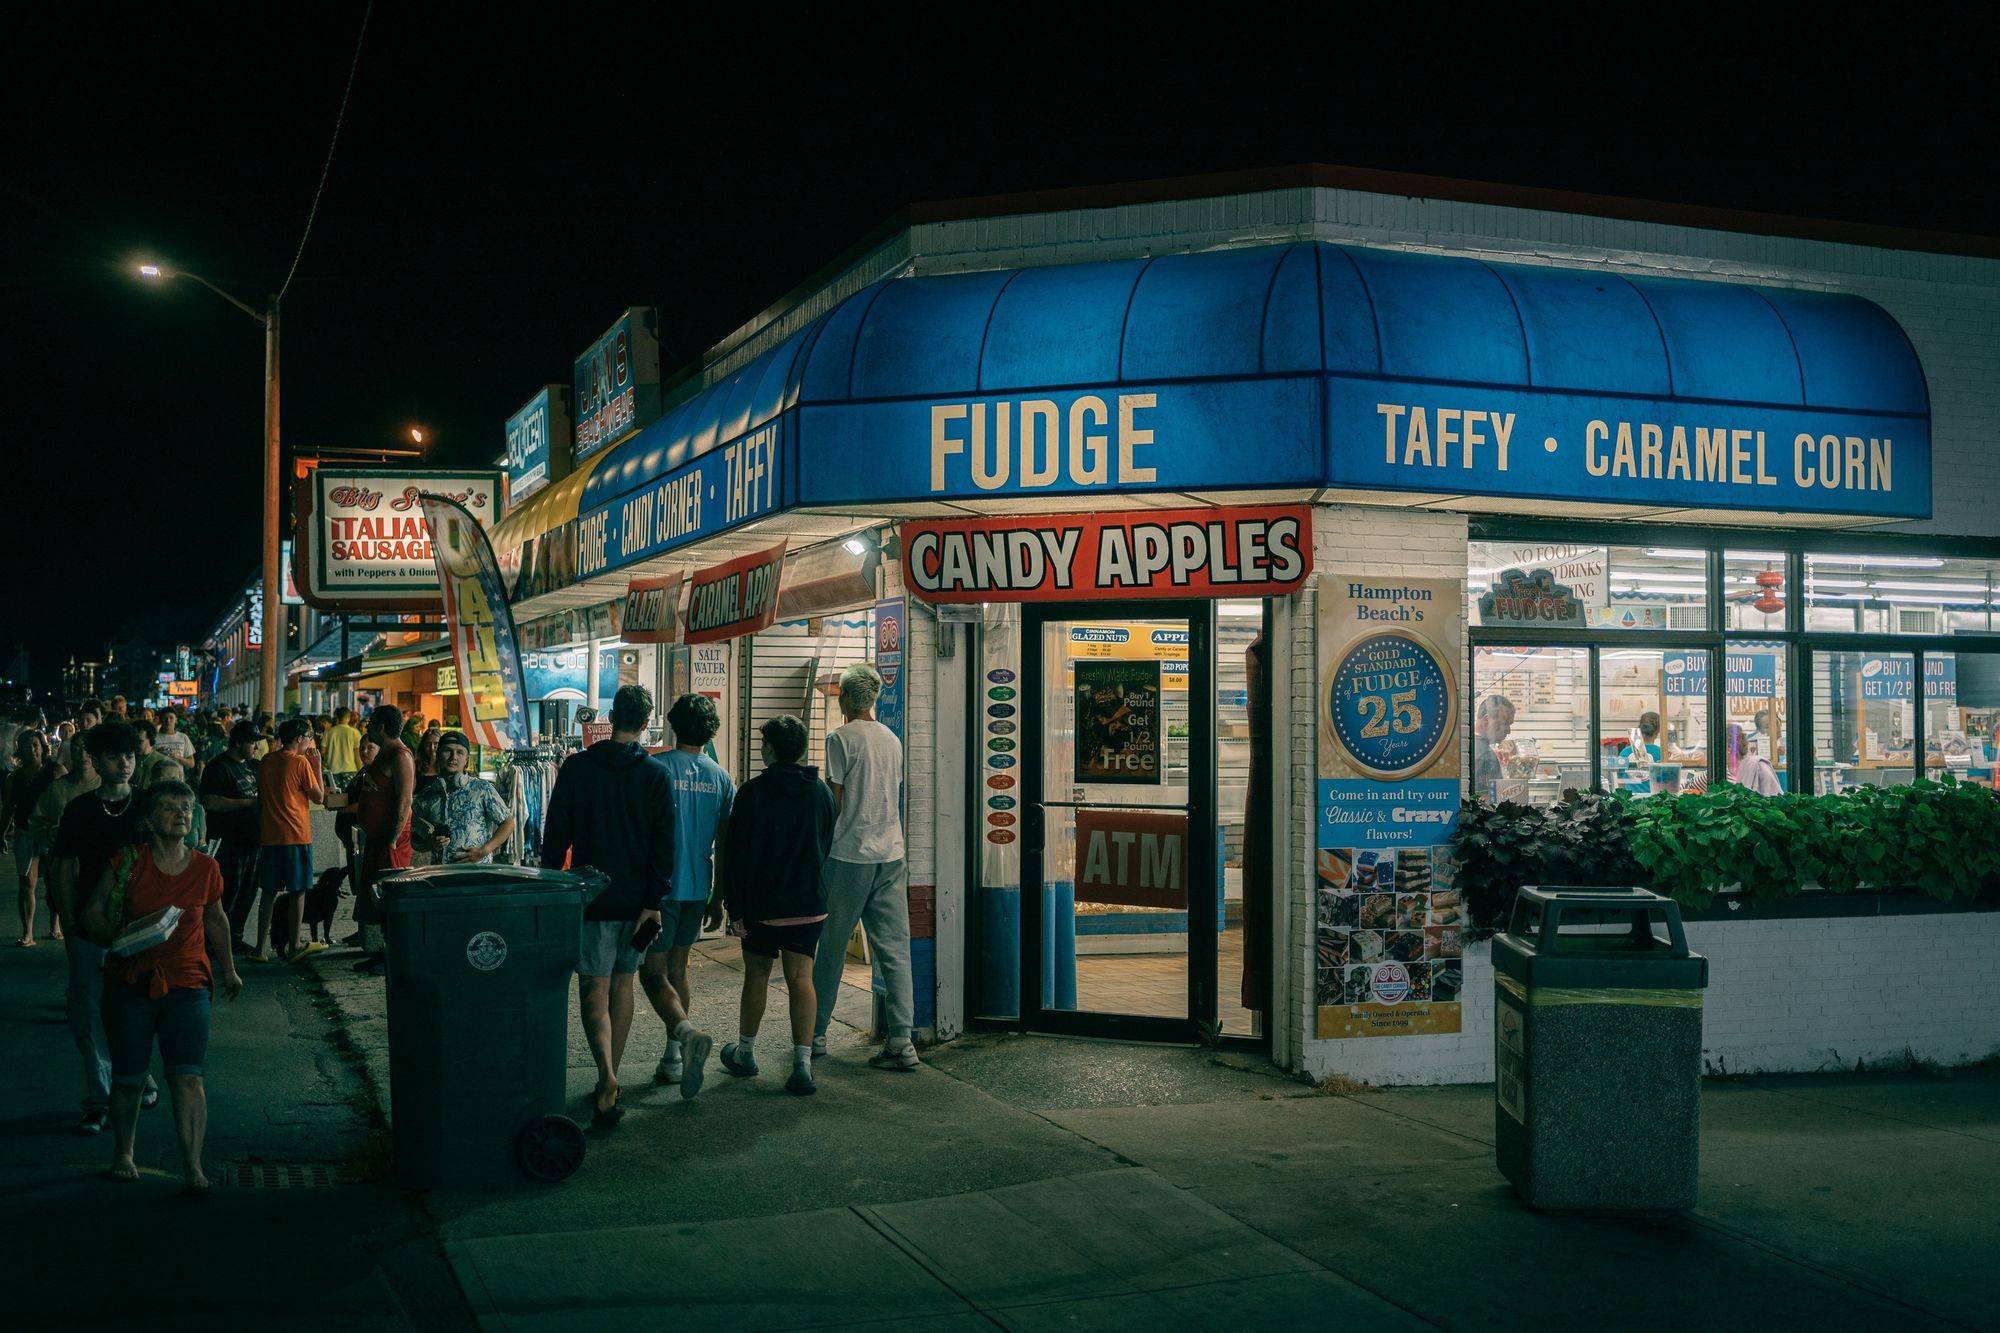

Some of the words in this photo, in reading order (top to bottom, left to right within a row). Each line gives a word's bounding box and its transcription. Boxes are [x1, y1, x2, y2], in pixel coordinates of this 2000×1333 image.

[930, 393, 1157, 492] FUDGE
[1377, 403, 1516, 471] TAFFY
[1585, 419, 1777, 487] CARAMEL
[1793, 432, 1892, 492] CORN
[329, 486, 383, 511] Big
[577, 509, 609, 577] FUDGE
[621, 490, 654, 557] CANDY
[656, 469, 702, 545] CORNER
[725, 423, 777, 524] TAFFY
[908, 526, 1083, 593] CANDY
[1095, 516, 1303, 588] APPLES
[1512, 548, 1533, 564] NO
[1535, 545, 1578, 561] FOOD
[335, 568, 354, 577] with
[357, 568, 396, 579] Peppers
[400, 567, 406, 577] &
[409, 568, 437, 577] Onion
[1560, 561, 1602, 579] DRINKS
[1348, 584, 1433, 603] Hampton
[623, 588, 664, 632] GLAZED
[687, 572, 741, 633] CARAMEL
[1494, 597, 1570, 621] FUDGE
[1356, 605, 1424, 622] Beach's
[1072, 633, 1105, 641] GLAZED
[1106, 633, 1128, 642] NUTS
[1153, 633, 1188, 641] APPL
[521, 653, 548, 669] ABC
[568, 653, 616, 670] OCAN
[698, 649, 721, 661] SALT
[1368, 649, 1400, 662] GOLD
[693, 662, 726, 674] WATER
[1354, 657, 1416, 674] STANDARD
[1686, 656, 1707, 672] BUY
[1883, 661, 1902, 676] BUY
[1905, 661, 1910, 676] 1
[1924, 661, 1944, 676] UND
[1351, 670, 1422, 694] FUDGE
[1422, 676, 1434, 691] for
[1667, 677, 1686, 692] GET
[1689, 677, 1707, 693] 1/2
[1747, 678, 1772, 694] FREE
[1865, 681, 1883, 696] GET
[1886, 681, 1903, 696] 1/2
[1939, 681, 1956, 696] FRE
[1123, 697, 1155, 707] Pound
[1129, 692, 1144, 701] Buy
[1127, 714, 1149, 726] Get
[1357, 688, 1423, 740] 25
[587, 725, 613, 734] SWEDIS
[1129, 731, 1151, 744] 1/2
[1123, 741, 1155, 751] Pound
[1378, 738, 1409, 758] Years
[1103, 748, 1155, 770] Free
[1329, 789, 1364, 801] Come
[1367, 788, 1379, 800] in
[1382, 788, 1405, 801] and
[1407, 790, 1425, 803] try
[1427, 791, 1449, 801] our
[1325, 805, 1374, 825] Classic
[1376, 810, 1387, 822] &
[1391, 807, 1454, 825] Crazy
[1366, 828, 1413, 841] flavors!
[1083, 830, 1182, 890] ATM
[1350, 1011, 1371, 1020] Family
[1401, 1008, 1431, 1018] Operated
[1371, 1019, 1391, 1027] Since
